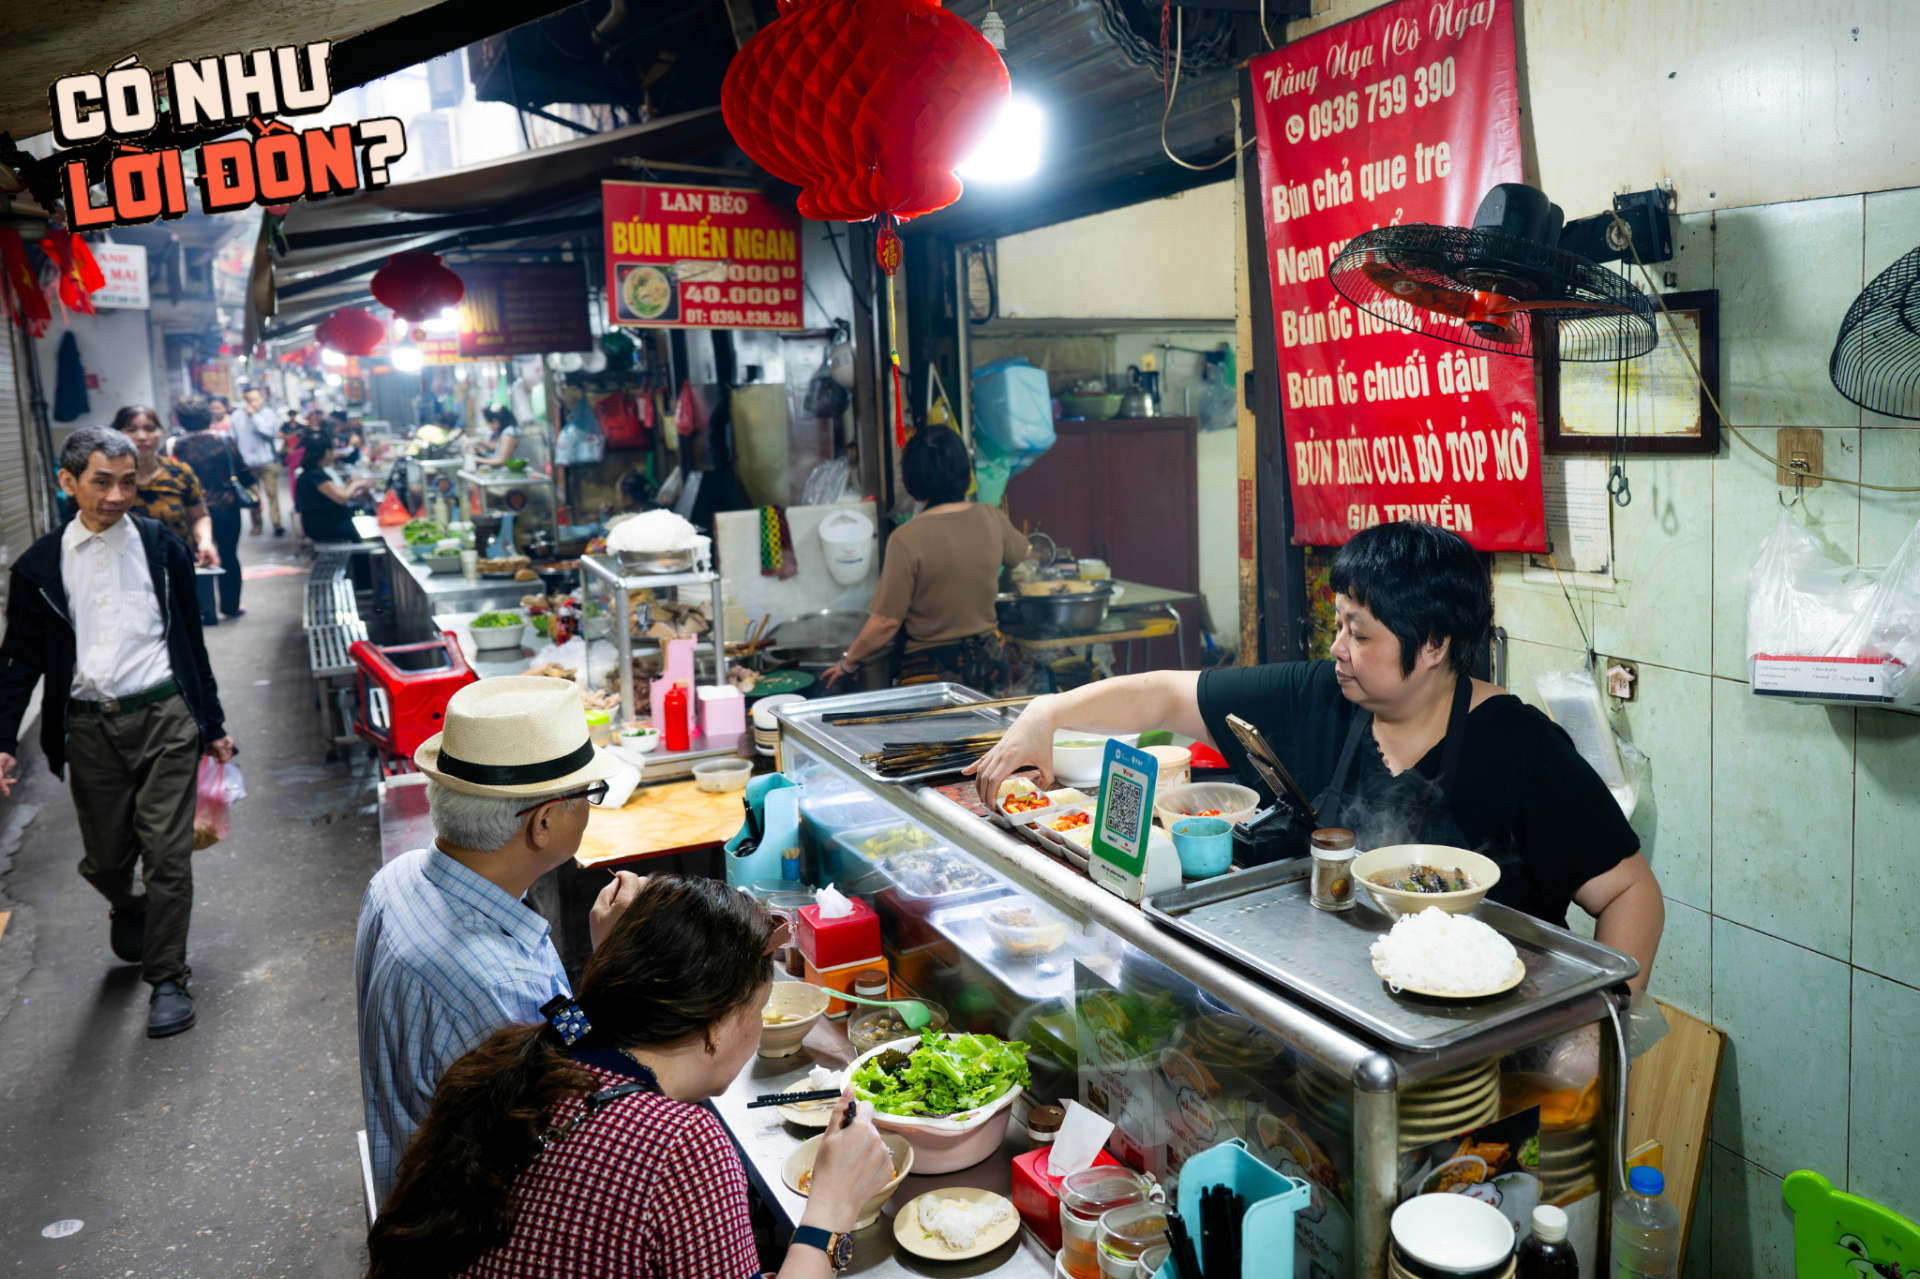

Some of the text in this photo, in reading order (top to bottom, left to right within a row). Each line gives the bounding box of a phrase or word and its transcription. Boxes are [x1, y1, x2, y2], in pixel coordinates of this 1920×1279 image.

[1263, 0, 1495, 103] Hằng Nga (Cô Nga)
[1309, 56, 1456, 141] 0936 759 390
[660, 189, 748, 215] LAN BÉO
[1272, 141, 1451, 224] Bún chả que tre
[612, 214, 796, 261] BÚN MIẾN NGAN
[882, 238, 897, 268] 福
[1276, 245, 1324, 286] Nem
[1281, 306, 1327, 348] Bún
[1328, 294, 1352, 341] ốc
[1287, 349, 1489, 409] Bún ốc chuối đậu
[1295, 410, 1529, 486] BÚN RIÊU CUA BÒ TÓP MỠ
[1347, 504, 1379, 530] GIA
